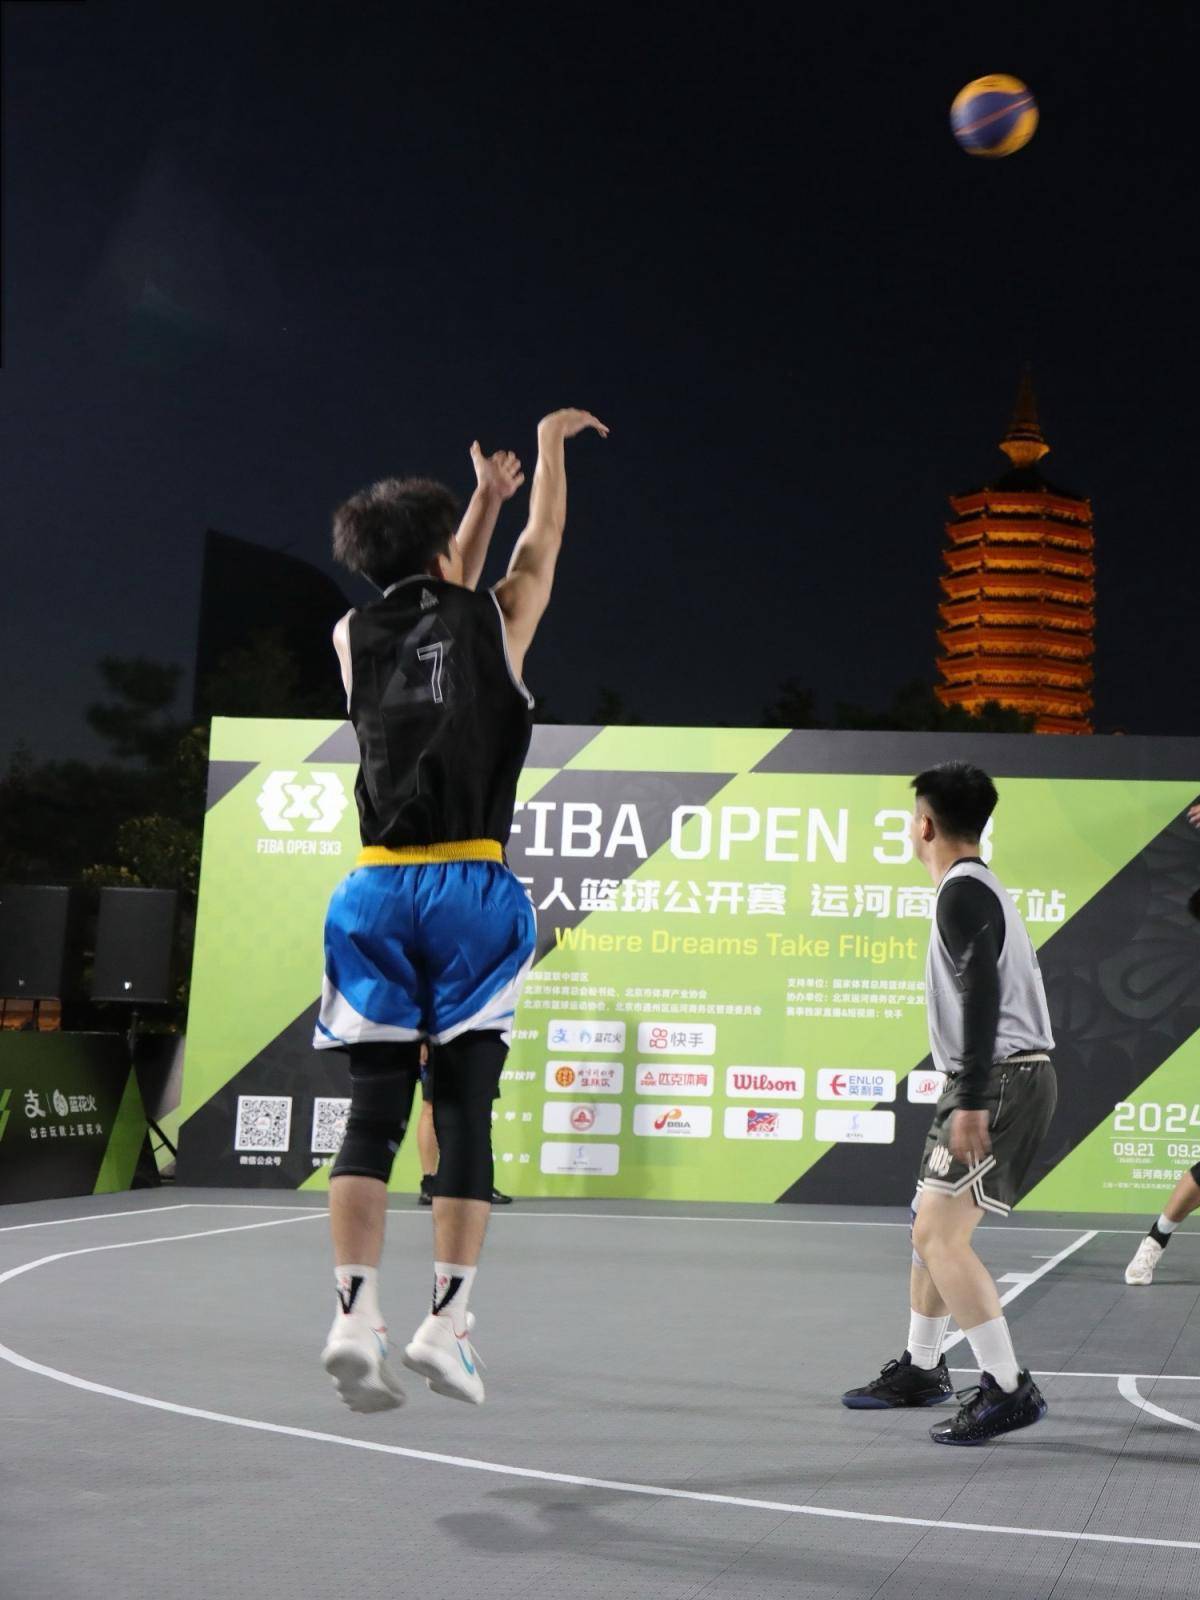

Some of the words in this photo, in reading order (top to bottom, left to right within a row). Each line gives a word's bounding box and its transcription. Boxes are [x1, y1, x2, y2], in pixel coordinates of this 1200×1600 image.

[416, 640, 443, 704] 7
[670, 805, 848, 863] OPEN
[257, 838, 284, 854] FIBA
[287, 839, 317, 855] OPEN
[320, 840, 342, 855] 3X3
[555, 927, 642, 951] Where
[652, 931, 758, 955] Dreams
[767, 934, 829, 957] Take
[839, 935, 918, 962] Flight
[671, 1032, 704, 1048] 快手
[659, 1072, 708, 1087] 匹克体育
[733, 1073, 797, 1092] Wilson
[849, 1075, 884, 1086] ENLIO
[1113, 1142, 1155, 1157] 09.21
